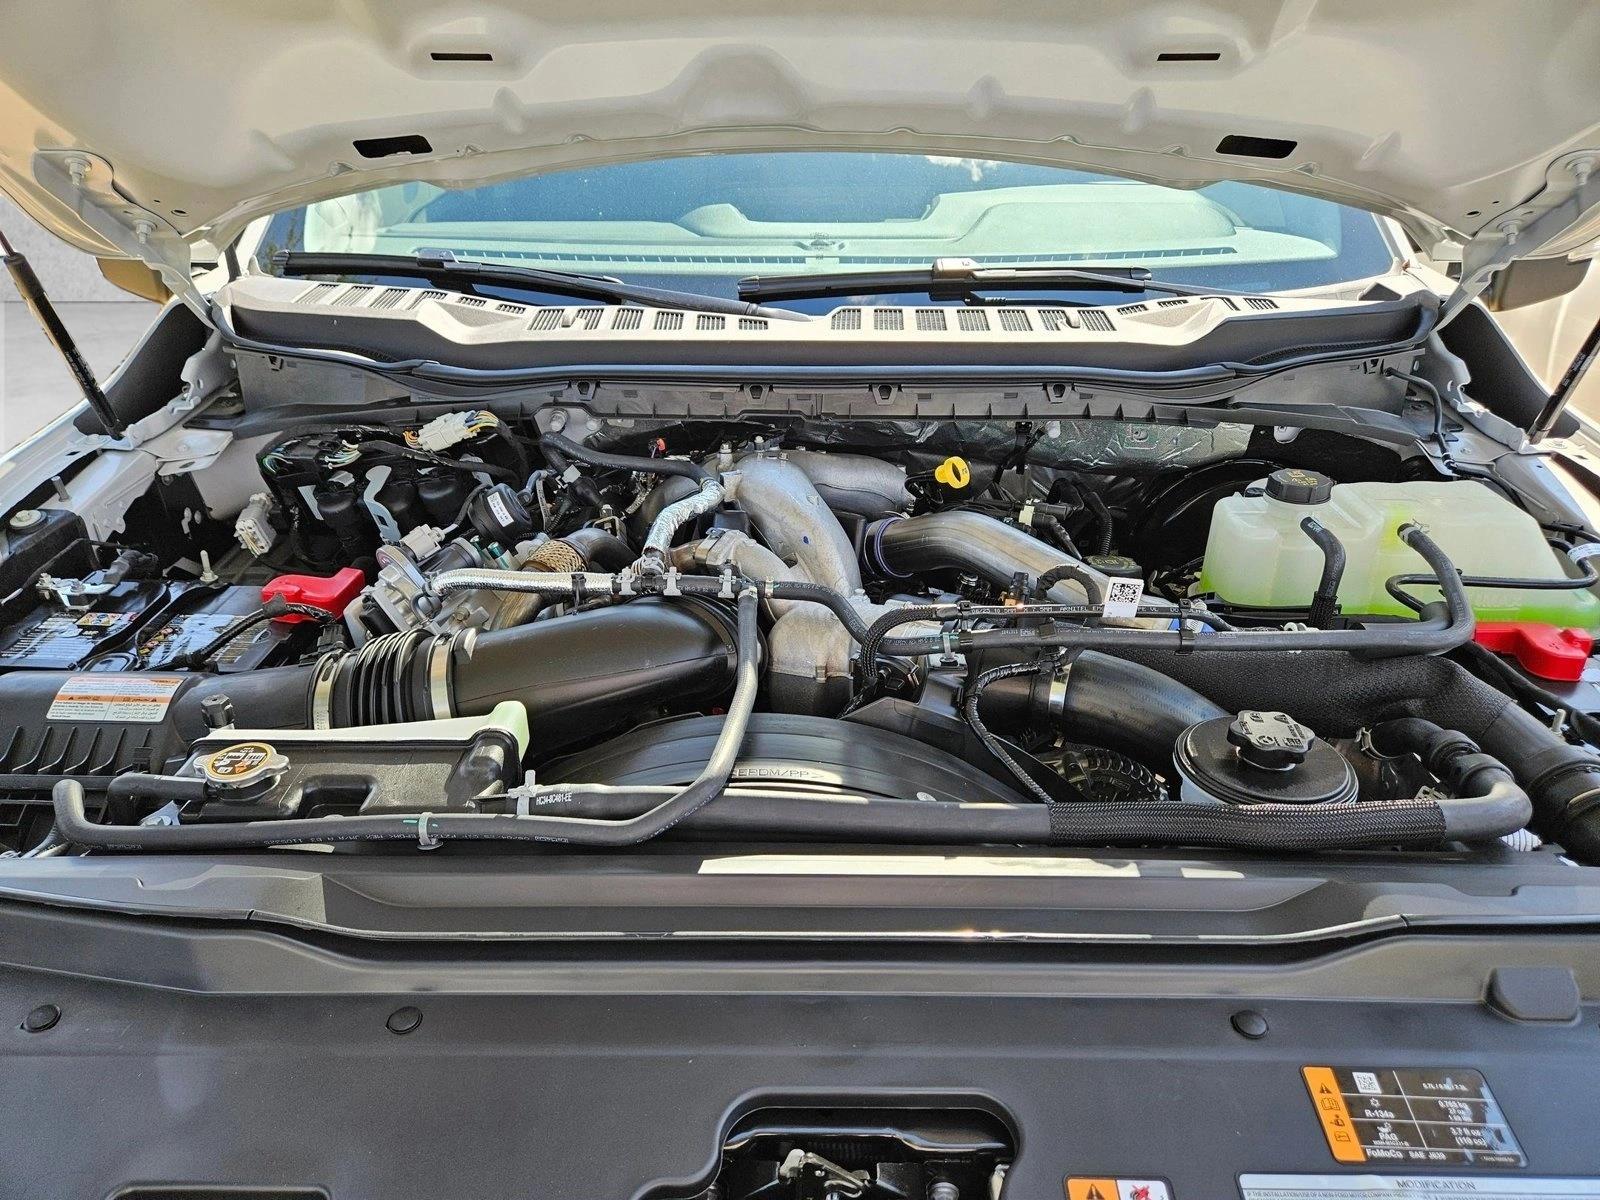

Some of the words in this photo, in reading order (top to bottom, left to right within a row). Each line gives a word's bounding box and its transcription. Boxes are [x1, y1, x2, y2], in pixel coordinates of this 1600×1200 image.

[1364, 1109, 1396, 1119] R-134a
[1366, 1149, 1404, 1159] FoMoCo
[1396, 1180, 1477, 1191] MODIFICATION
